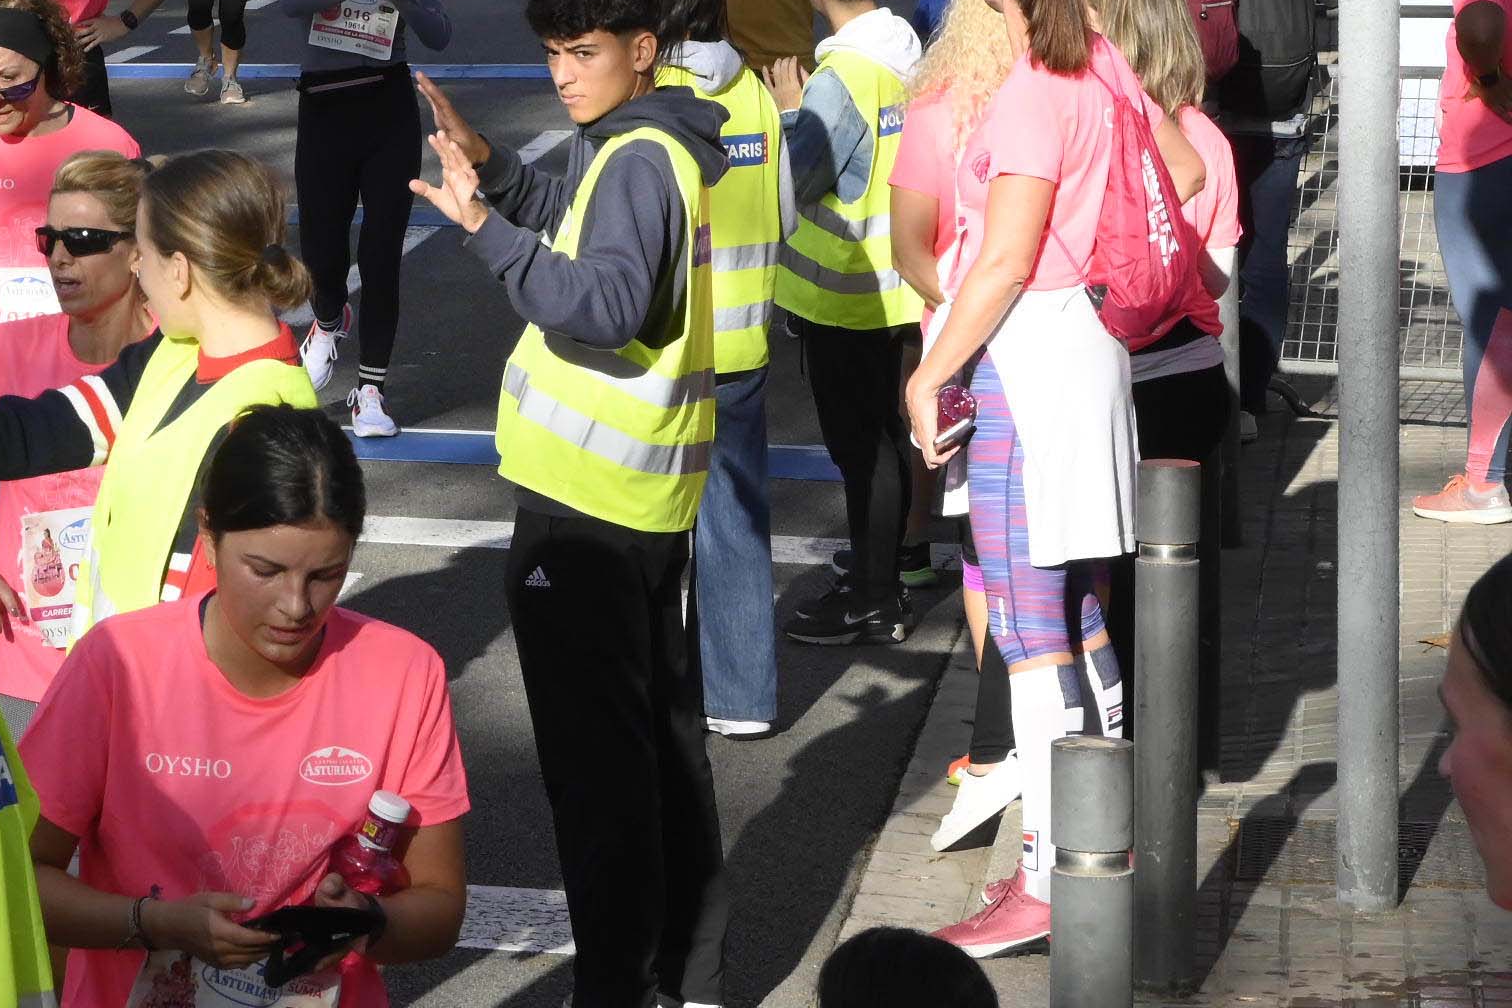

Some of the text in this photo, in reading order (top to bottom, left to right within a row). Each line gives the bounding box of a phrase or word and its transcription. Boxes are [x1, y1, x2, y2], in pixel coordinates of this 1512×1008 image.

[343, 7, 370, 21] 016
[524, 578, 551, 587] adidas
[145, 752, 232, 779] OYSHO
[304, 761, 367, 777] ASTURIANA
